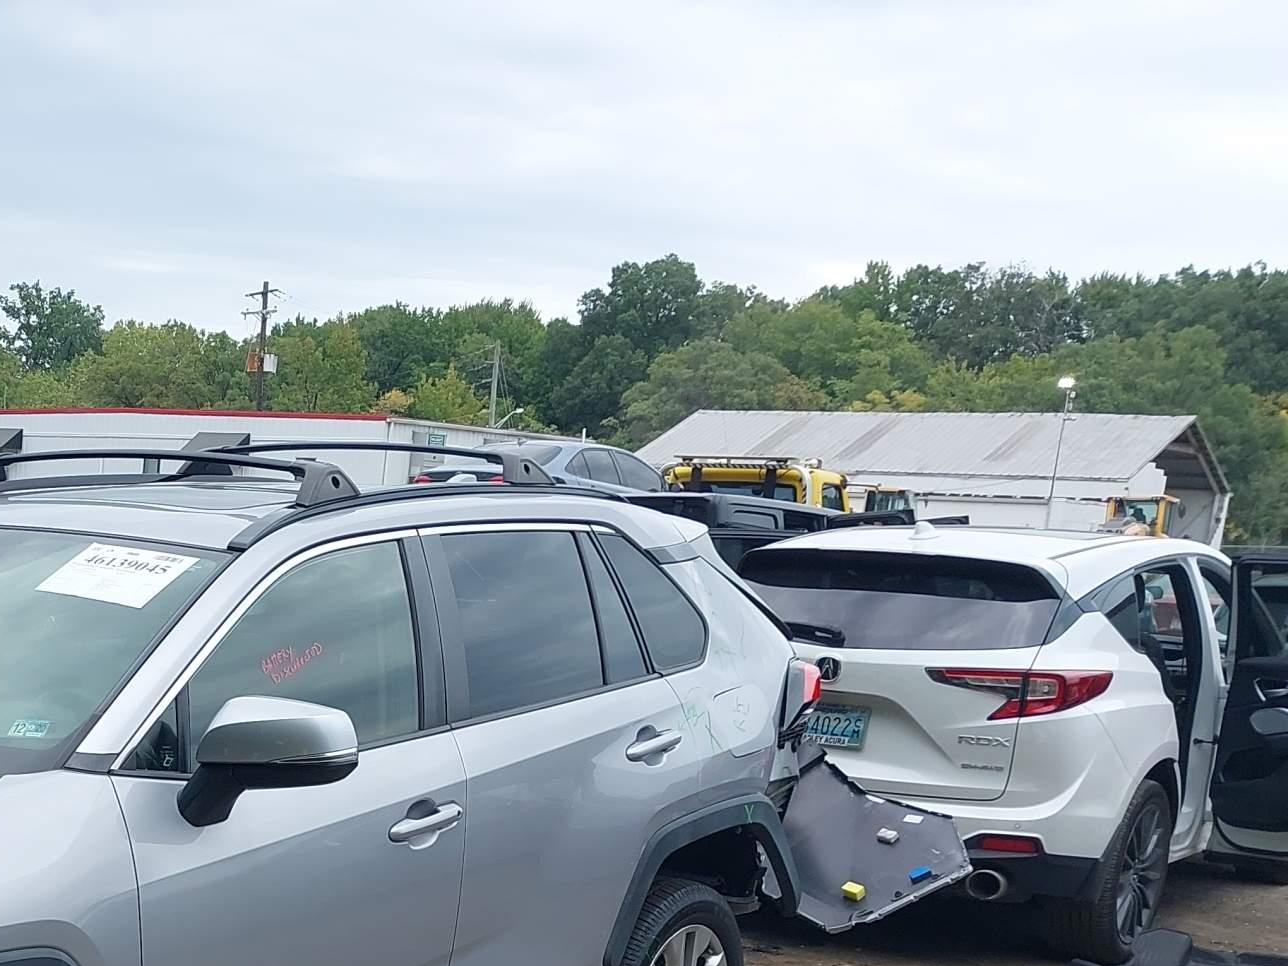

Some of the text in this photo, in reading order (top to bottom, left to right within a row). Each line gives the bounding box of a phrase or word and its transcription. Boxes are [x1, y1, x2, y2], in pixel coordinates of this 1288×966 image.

[85, 554, 172, 575] 46139045
[807, 715, 852, 738] 4022
[958, 735, 1010, 748] RDX
